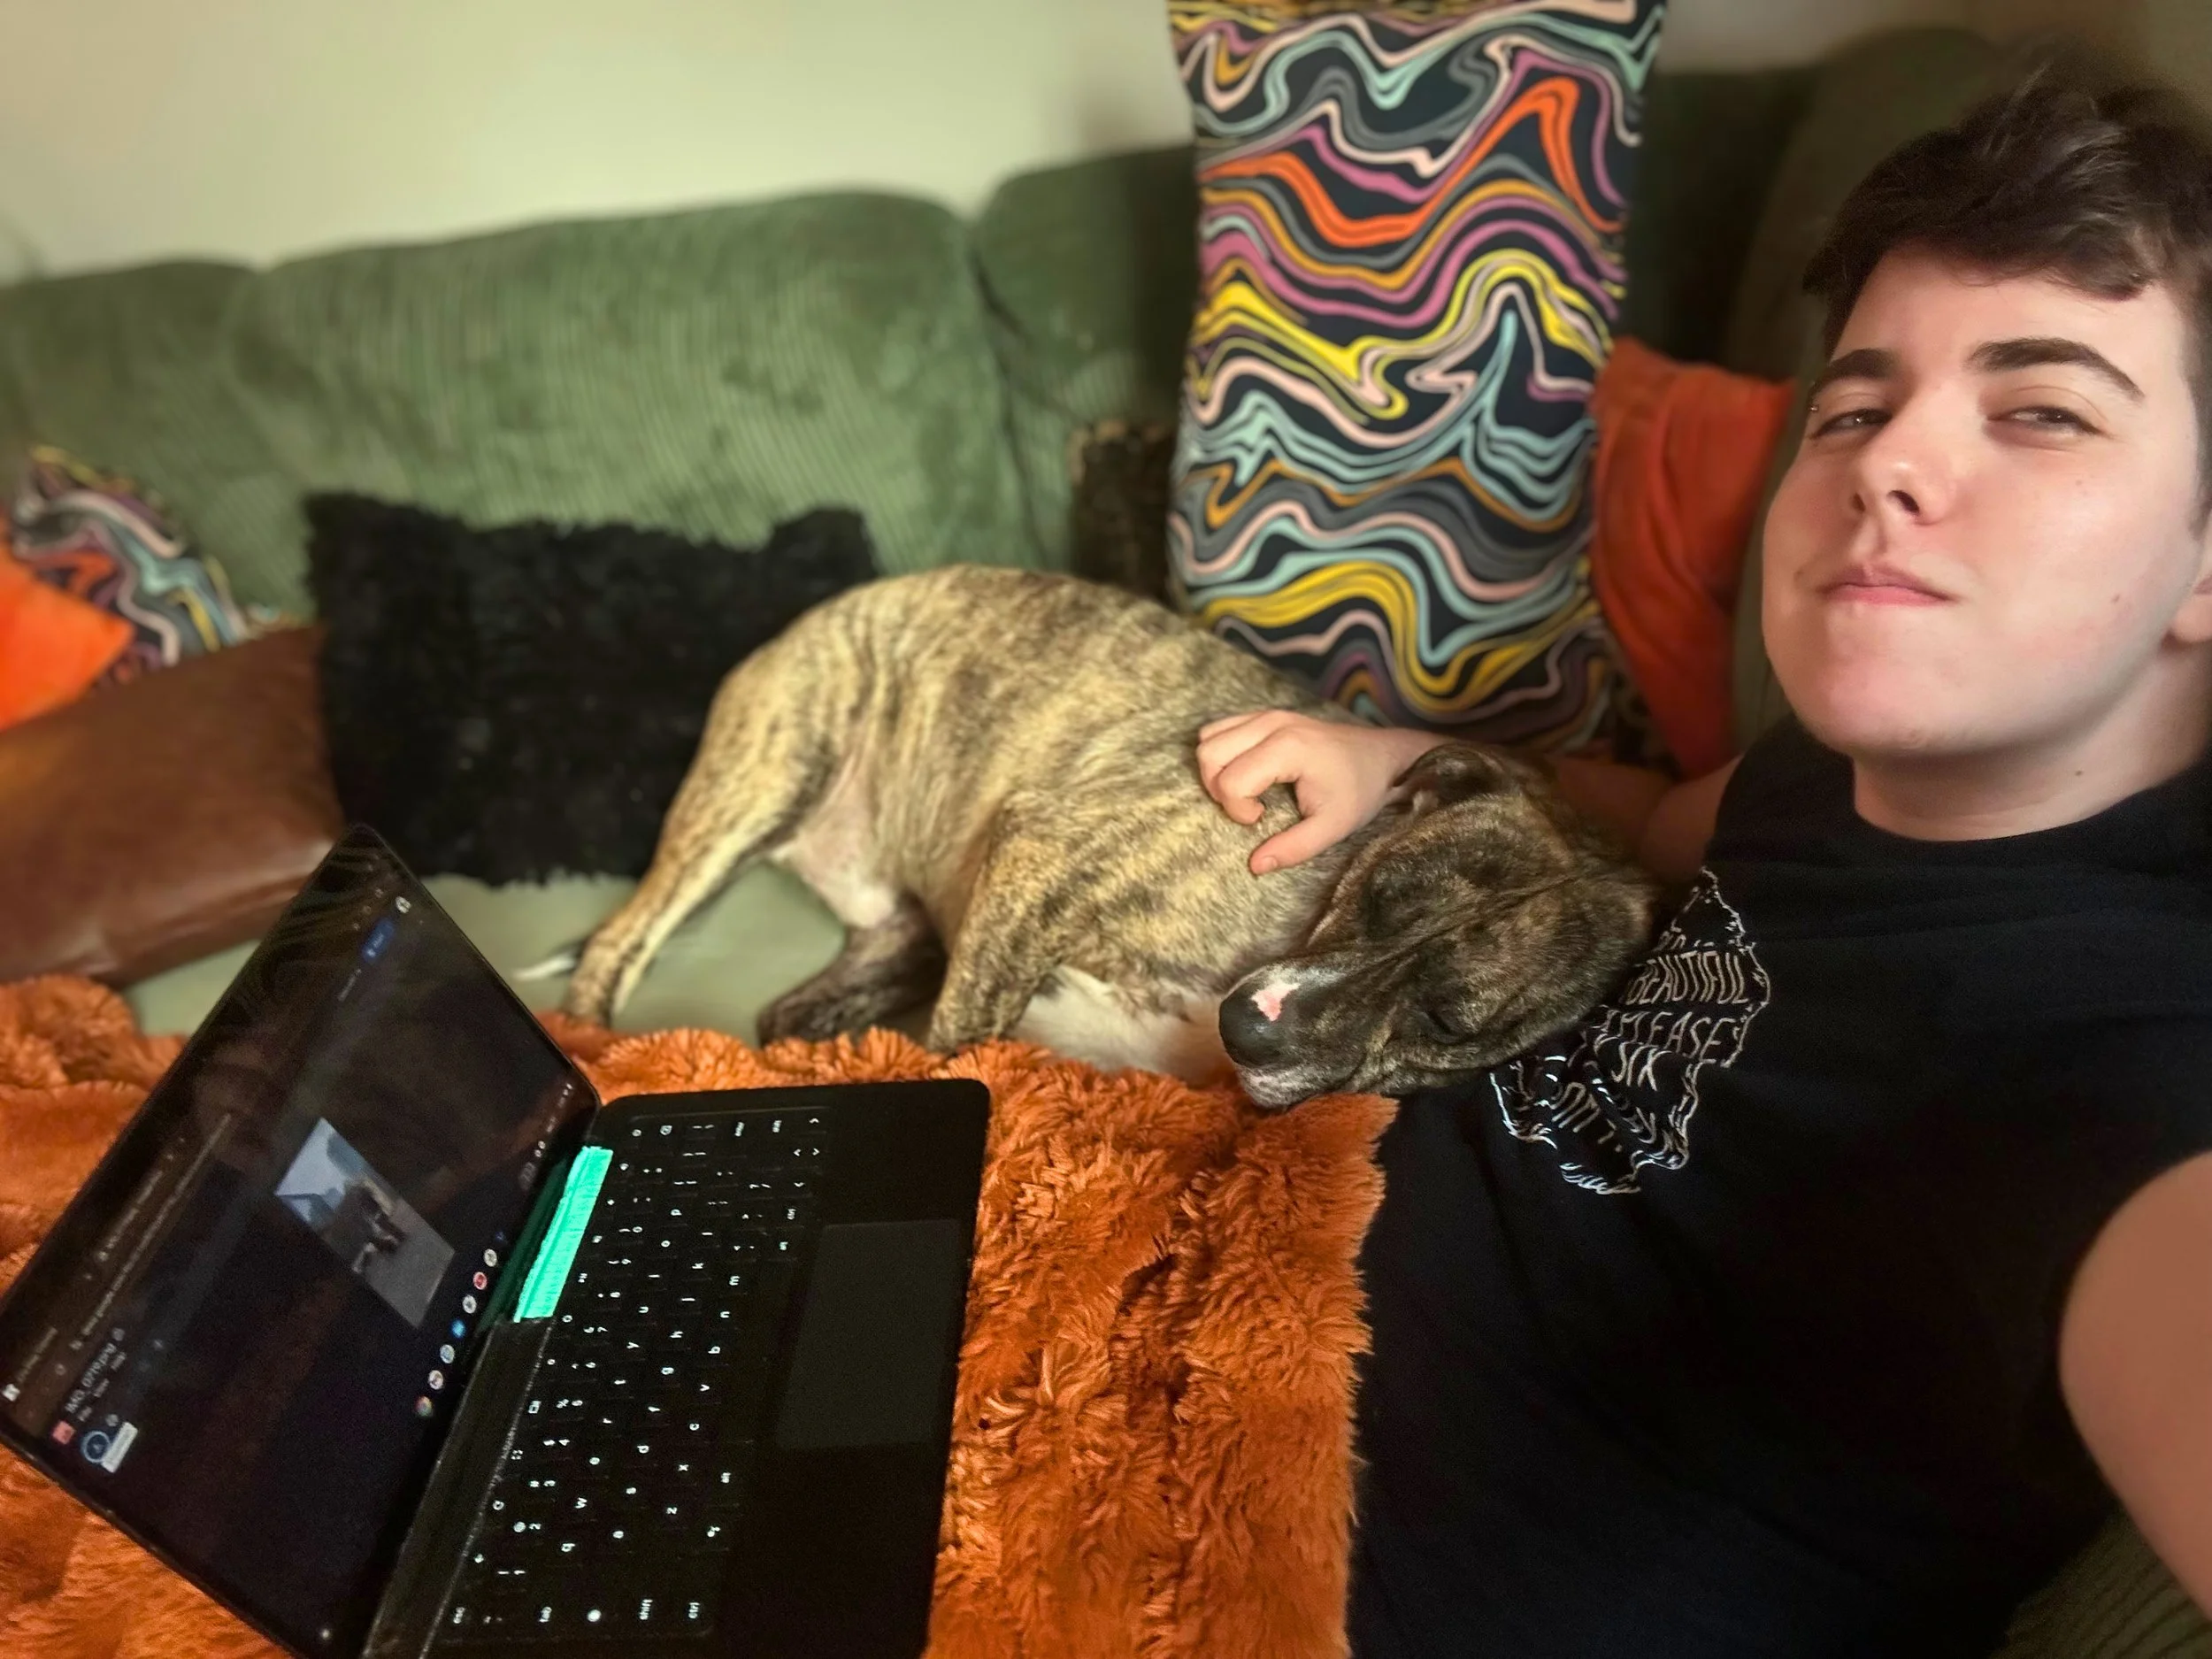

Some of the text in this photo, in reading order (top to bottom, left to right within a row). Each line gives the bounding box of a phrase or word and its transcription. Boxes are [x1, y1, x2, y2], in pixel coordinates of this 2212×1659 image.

[728, 1275, 741, 1286] m
[560, 1542, 576, 1553] q
[639, 1598, 653, 1621] shift
[687, 1601, 701, 1619] ctrl
